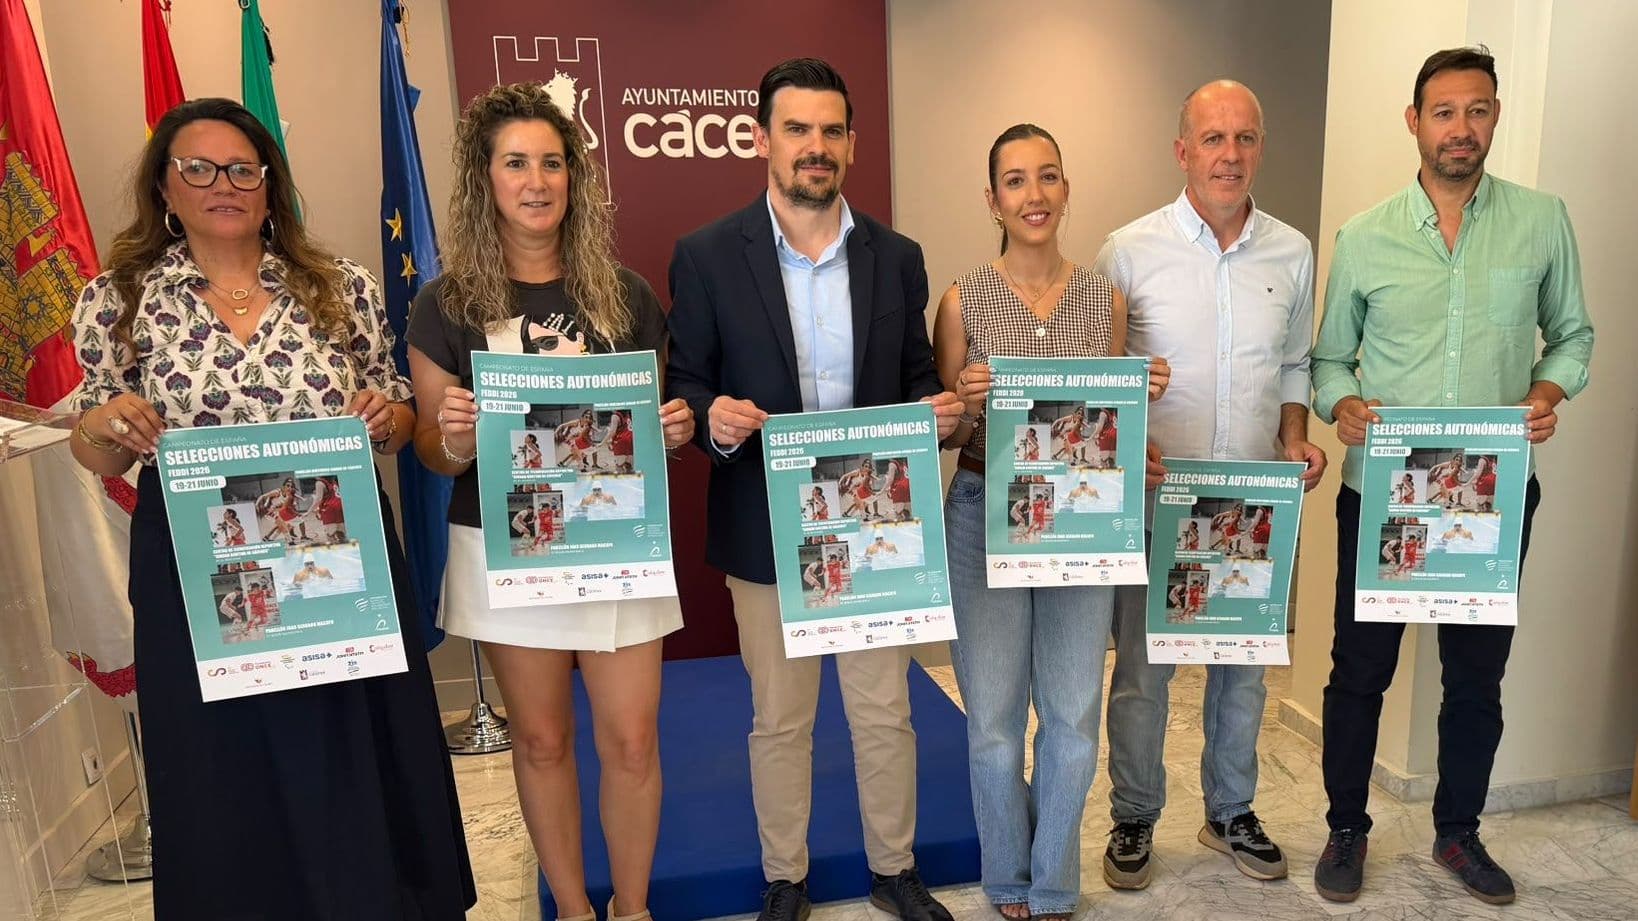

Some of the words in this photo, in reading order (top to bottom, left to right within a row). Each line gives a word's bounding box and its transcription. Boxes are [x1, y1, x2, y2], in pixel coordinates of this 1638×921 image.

[621, 87, 759, 107] AYUNTAMIENTO
[480, 371, 564, 389] SELECCIONES
[567, 371, 652, 389] AUTONÓMICAS
[993, 374, 1064, 387] SELECCIONES
[1066, 373, 1143, 388] AUTONÓMICAS
[481, 389, 499, 398] FEDDI
[486, 402, 503, 410] 19-21
[769, 428, 845, 446] SELECCIONES
[848, 421, 930, 440] AUTONÓMICAS
[1372, 423, 1443, 435] SELECCIONES
[1444, 422, 1524, 435] AUTONÓMICAS
[165, 444, 260, 466] SELECCIONES
[263, 435, 363, 458] AUTONÓMICAS
[770, 449, 787, 457] FEDDI
[788, 448, 804, 456] 2026
[168, 467, 190, 477] FEDDI
[175, 480, 196, 490] 19-21
[197, 479, 219, 488] JUNIO
[1163, 473, 1227, 486] SELECCIONES
[1228, 474, 1299, 489] AUTONÓMICAS
